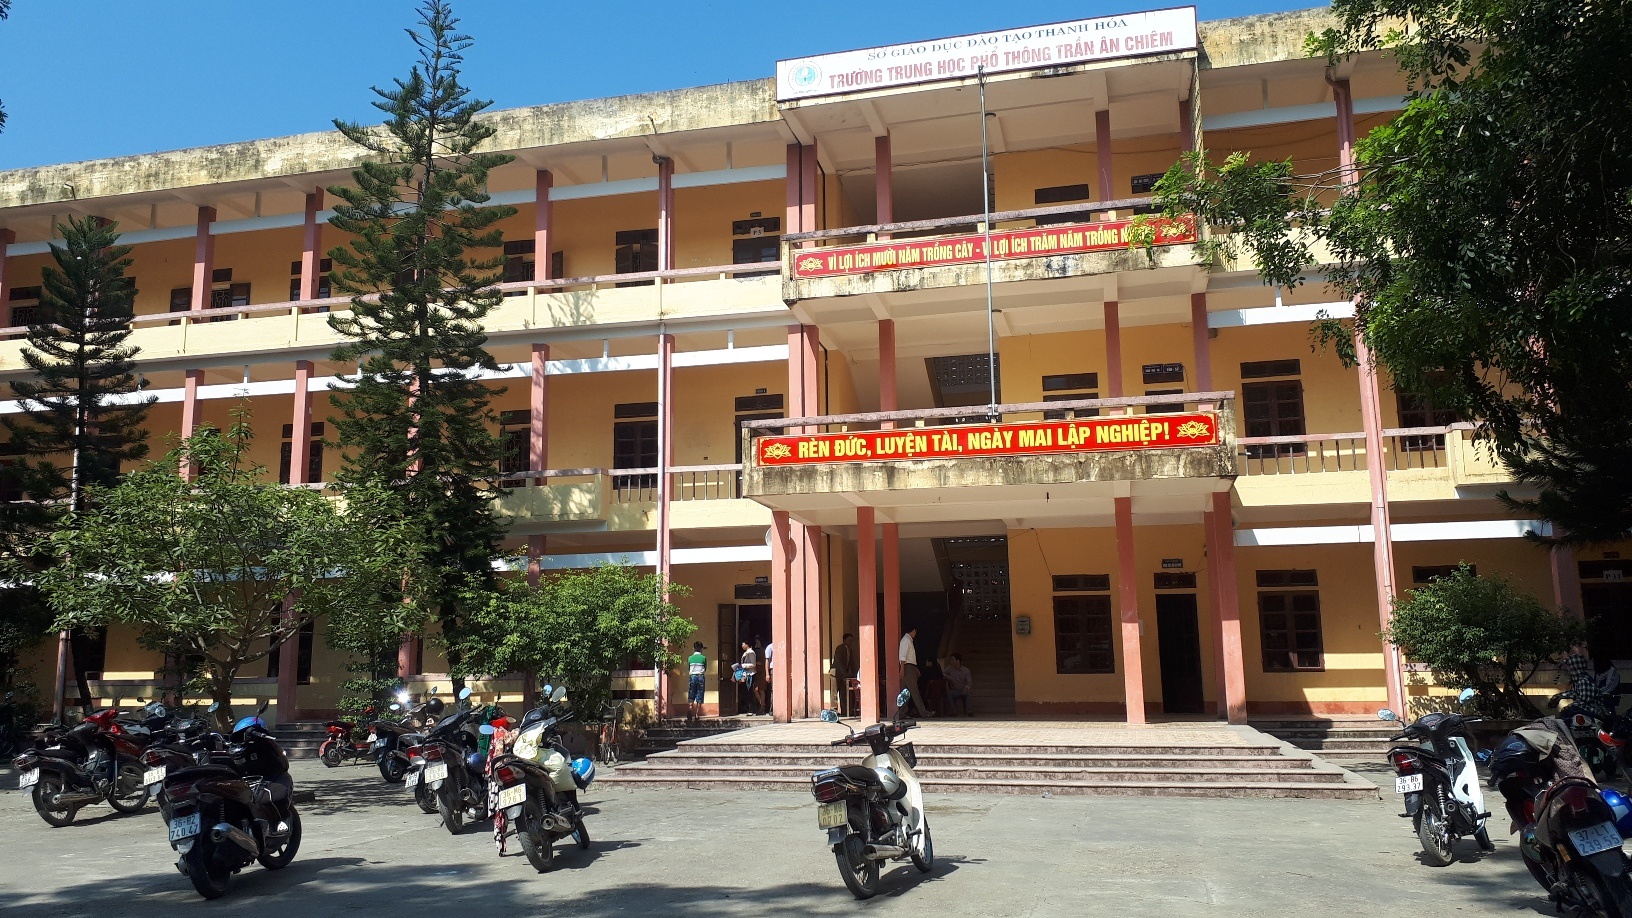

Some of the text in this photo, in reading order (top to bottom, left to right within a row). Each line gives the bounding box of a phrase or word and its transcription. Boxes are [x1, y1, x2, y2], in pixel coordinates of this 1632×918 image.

[829, 67, 883, 89] TRƯỜNG
[887, 62, 933, 81] TRUNG
[937, 58, 966, 77] HỌC
[1004, 44, 1052, 66] THÔNG
[1056, 36, 1095, 60] TRẦN
[1099, 35, 1120, 55] ÂN
[1125, 30, 1174, 52] CHIÊM
[931, 40, 963, 53] DỤC
[1002, 30, 1032, 43] TẠO
[1035, 23, 1089, 39] THANH
[828, 254, 837, 271] VÌ
[839, 252, 853, 273] LỢI
[855, 250, 870, 268] ÍCH
[872, 246, 896, 267] MƯỜI
[899, 245, 920, 264] NĂM
[922, 242, 952, 262] TRỒNG
[955, 240, 974, 259] CÂY
[993, 238, 1009, 258] LỢI
[1011, 236, 1028, 254] ÍCH
[1029, 233, 1058, 252] TRĂM
[1059, 230, 1083, 249] NĂM
[1085, 225, 1119, 247] TRỒNG
[798, 420, 1170, 459] RÈN ĐỨC, LUYỆN TÀI, NGÀY MAI LẬP NGHIỆP!
